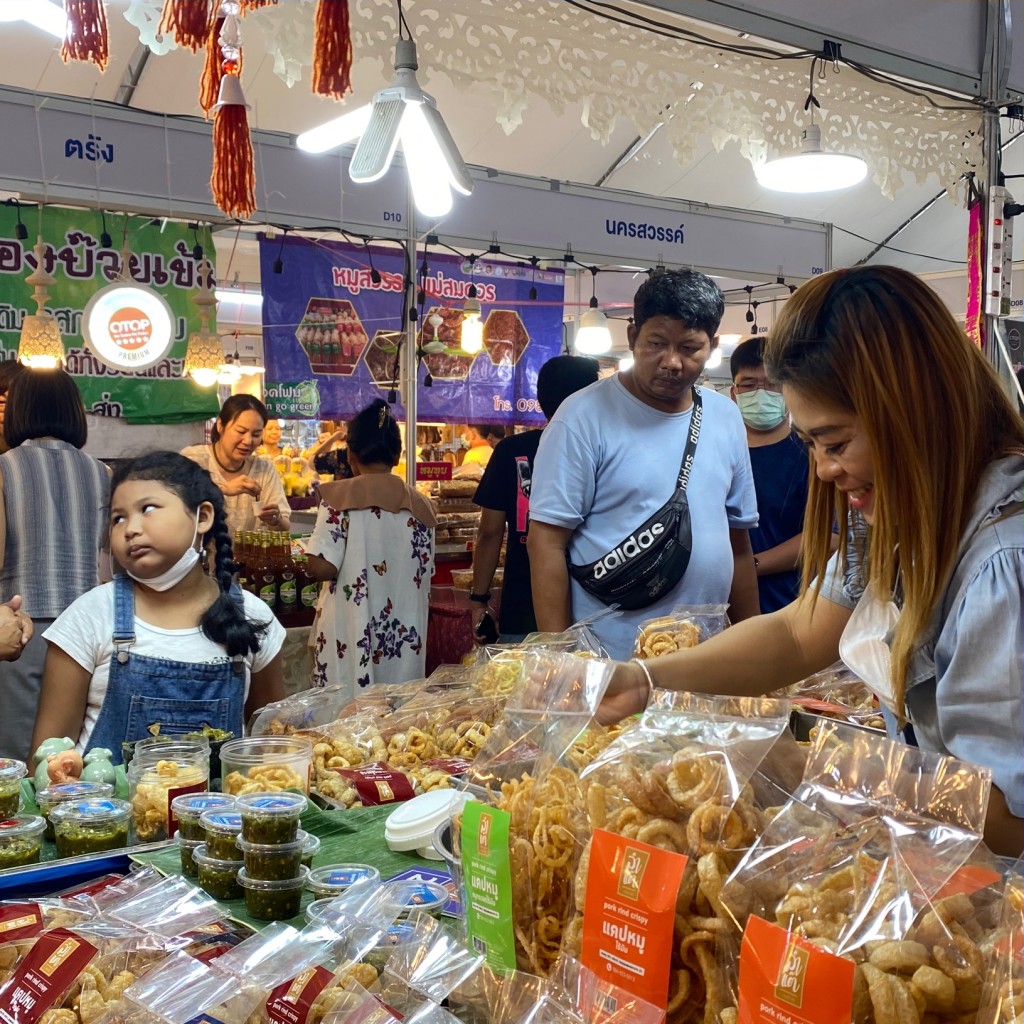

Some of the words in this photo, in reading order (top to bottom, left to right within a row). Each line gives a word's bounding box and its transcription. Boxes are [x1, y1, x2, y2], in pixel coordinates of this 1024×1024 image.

[64, 133, 114, 164] ตรัง
[383, 211, 402, 223] D10
[605, 219, 685, 244] นครสวรรค์
[811, 267, 823, 275] D09
[109, 318, 150, 334] OTOP
[118, 348, 150, 360] PREMIUM
[275, 403, 287, 412] go
[690, 404, 703, 445] adidas
[592, 522, 665, 579] adidas
[603, 902, 617, 913] pork
[617, 906, 630, 917] rind
[630, 911, 649, 926] crispy
[602, 920, 646, 955] แคปหมู
[760, 1003, 776, 1018] pork
